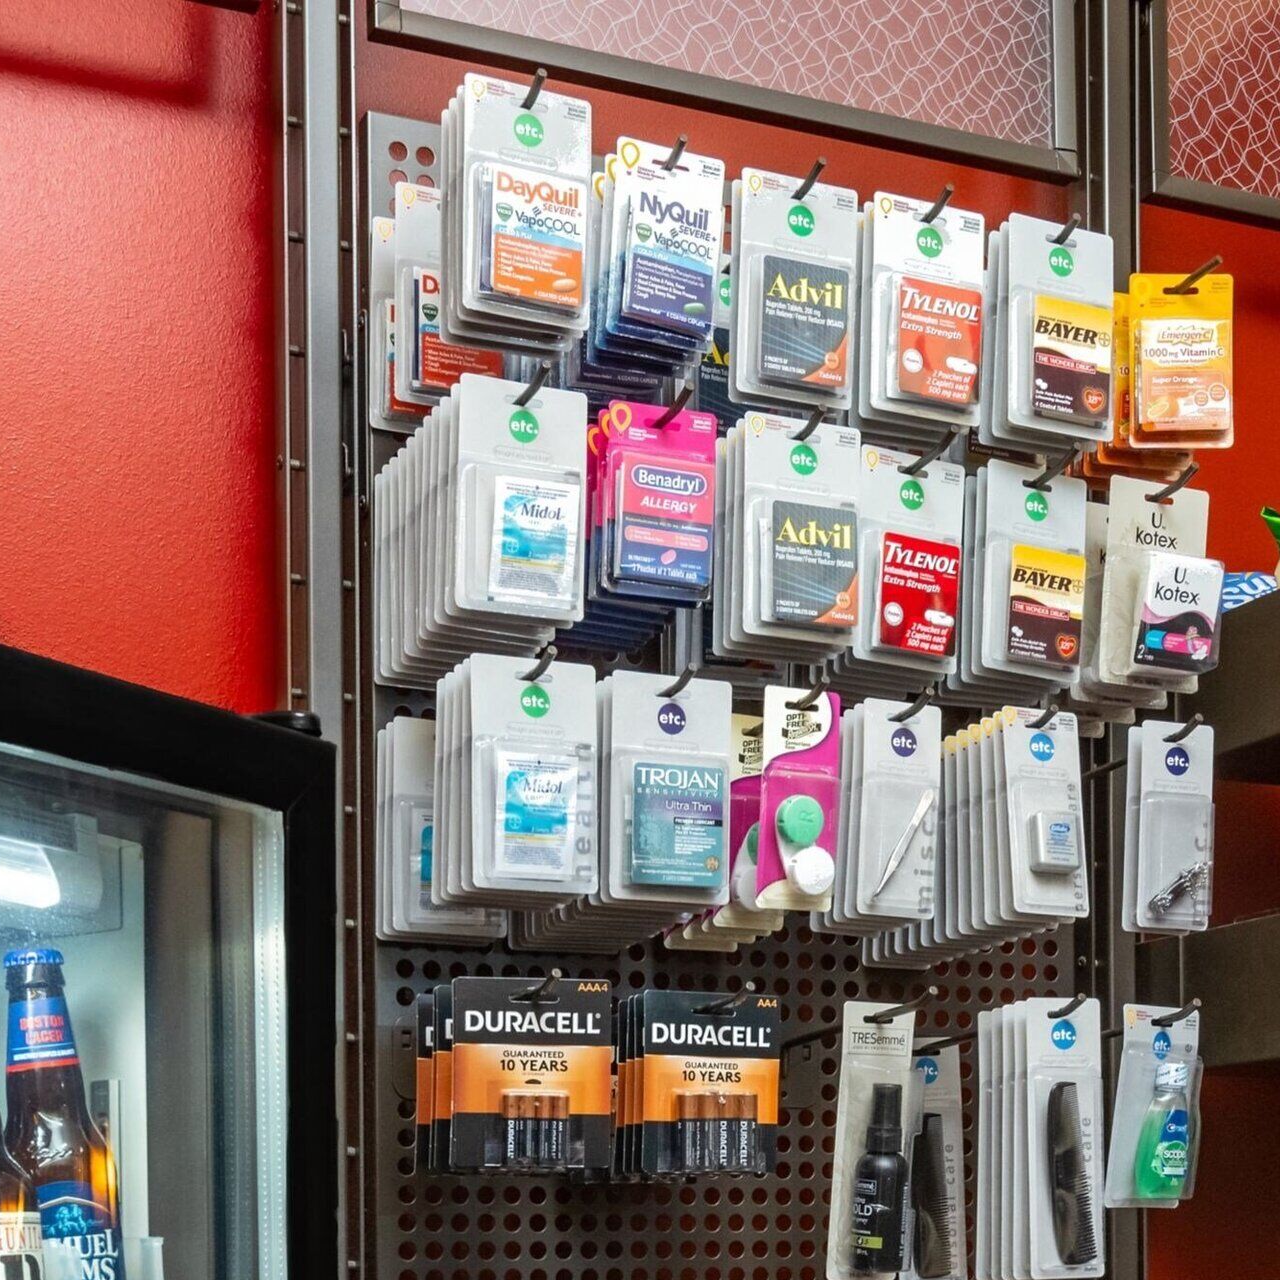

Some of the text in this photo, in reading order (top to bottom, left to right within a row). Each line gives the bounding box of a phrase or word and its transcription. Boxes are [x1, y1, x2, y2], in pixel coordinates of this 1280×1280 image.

[497, 171, 578, 208] DayQuil
[640, 191, 709, 230] NyQuil
[515, 210, 580, 235] VapoCOOL
[789, 214, 814, 229] etc.
[679, 225, 710, 241] SEVERE
[654, 230, 712, 259] VapoCOOL
[918, 237, 942, 250] etc.
[1050, 255, 1073, 269] etc.
[768, 273, 844, 309] Advil
[901, 287, 979, 321] TYLENOL
[925, 326, 962, 340] Strength
[1035, 319, 1097, 344] BAYER
[1145, 348, 1167, 357] 1000
[1180, 348, 1216, 357] Vitamin
[510, 421, 538, 434] etc.
[791, 454, 817, 468] etc.
[638, 469, 700, 493] Benadryl
[901, 488, 924, 502] etc.
[521, 502, 562, 520] Midol
[640, 496, 697, 514] ALLERGY
[1026, 501, 1047, 514] etc.
[776, 517, 851, 550] Advil
[1136, 527, 1177, 549] kotex
[885, 541, 958, 574] TYLENOL
[1012, 567, 1071, 592] BAYER
[1155, 584, 1199, 605] kotex
[521, 695, 549, 710] etc.
[660, 711, 685, 727] etc.
[893, 735, 917, 750] etc.
[1031, 739, 1054, 754] etc.
[1166, 753, 1189, 769] etc.
[637, 767, 719, 788] TROJAN
[665, 800, 712, 813] Ultra Thin
[465, 1011, 600, 1034] DURACELL
[652, 1022, 770, 1048] DURACELL
[852, 1031, 905, 1046] TRESemmé
[1052, 1029, 1076, 1042] etc.
[503, 1050, 563, 1058] GUARANTEED
[500, 1059, 568, 1072] 10 YEARS
[685, 1062, 738, 1070] GUARANTEED
[682, 1070, 741, 1083] 10 YEARS
